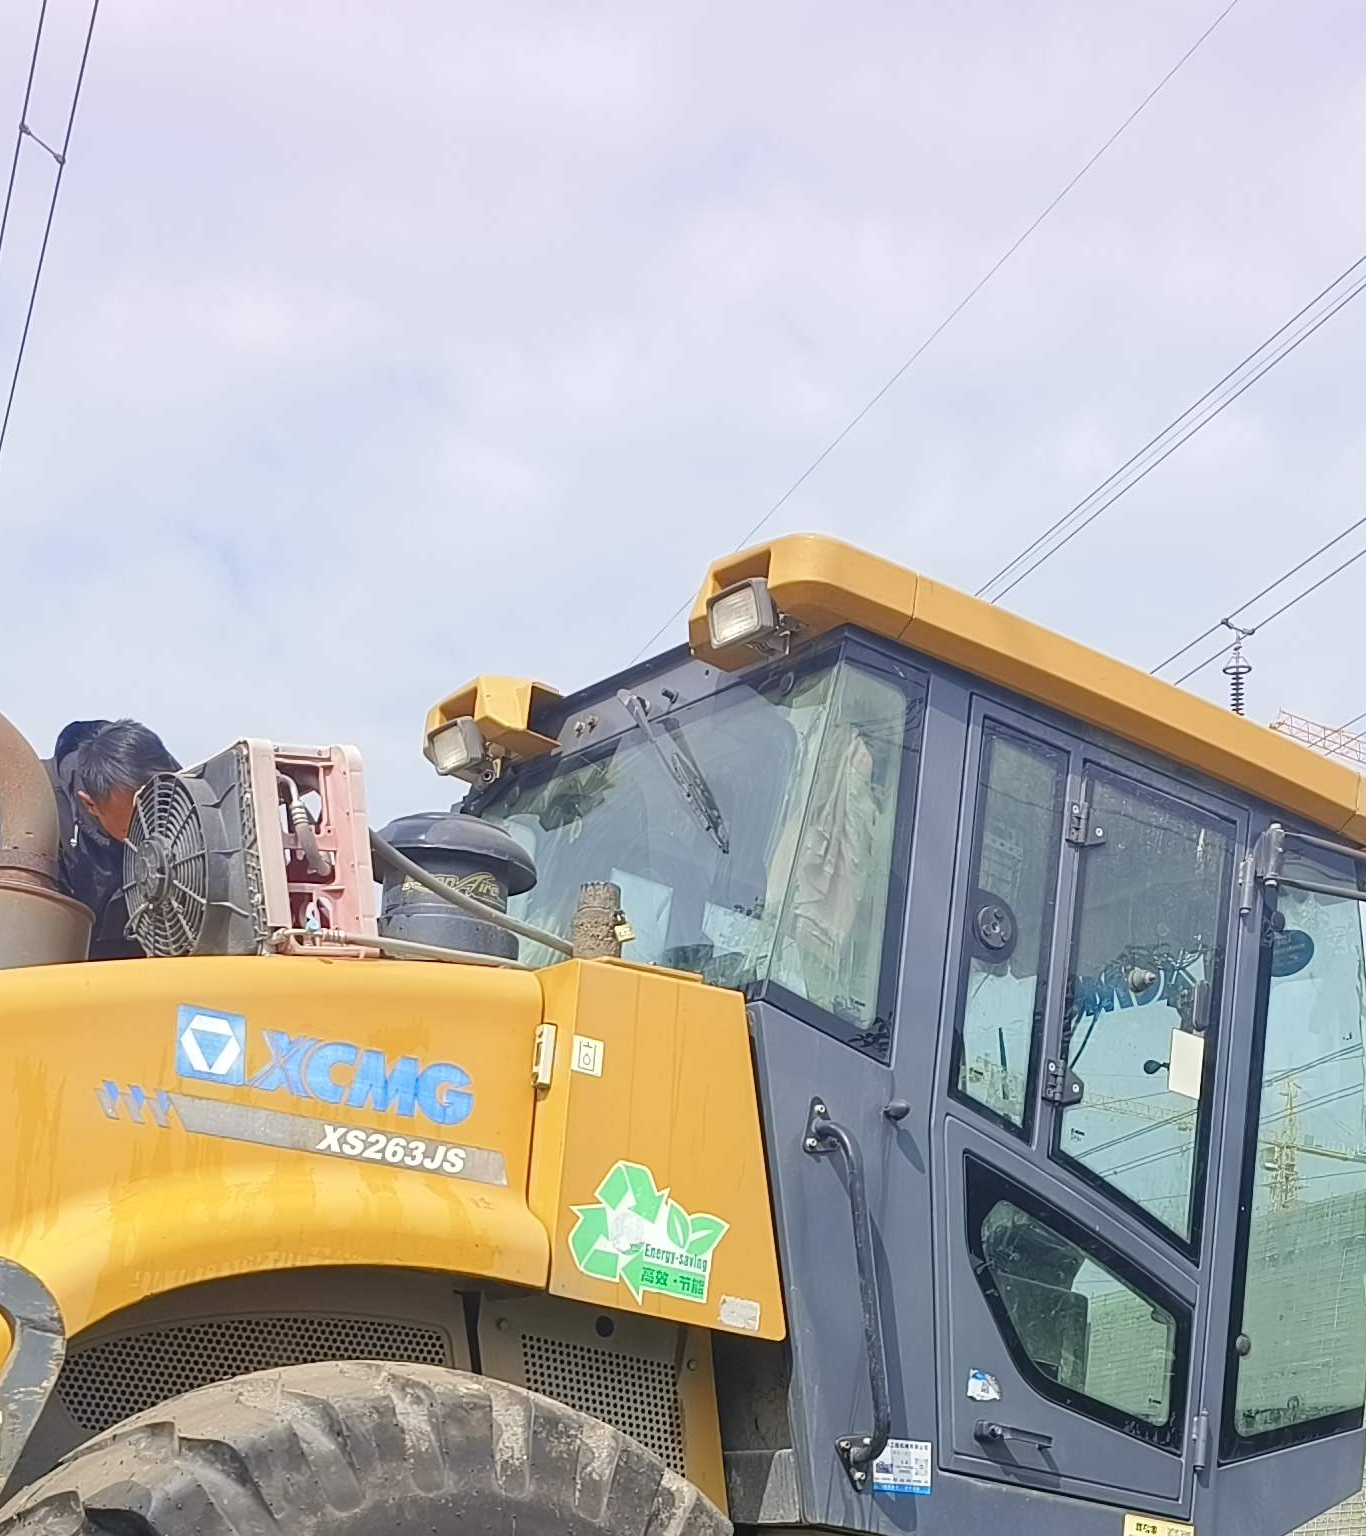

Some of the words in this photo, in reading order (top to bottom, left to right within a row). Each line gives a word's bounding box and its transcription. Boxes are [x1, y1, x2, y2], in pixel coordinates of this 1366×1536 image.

[247, 1030, 475, 1126] XCMG
[316, 1124, 467, 1174] XS263JS
[644, 1243, 708, 1273] Energy-saving
